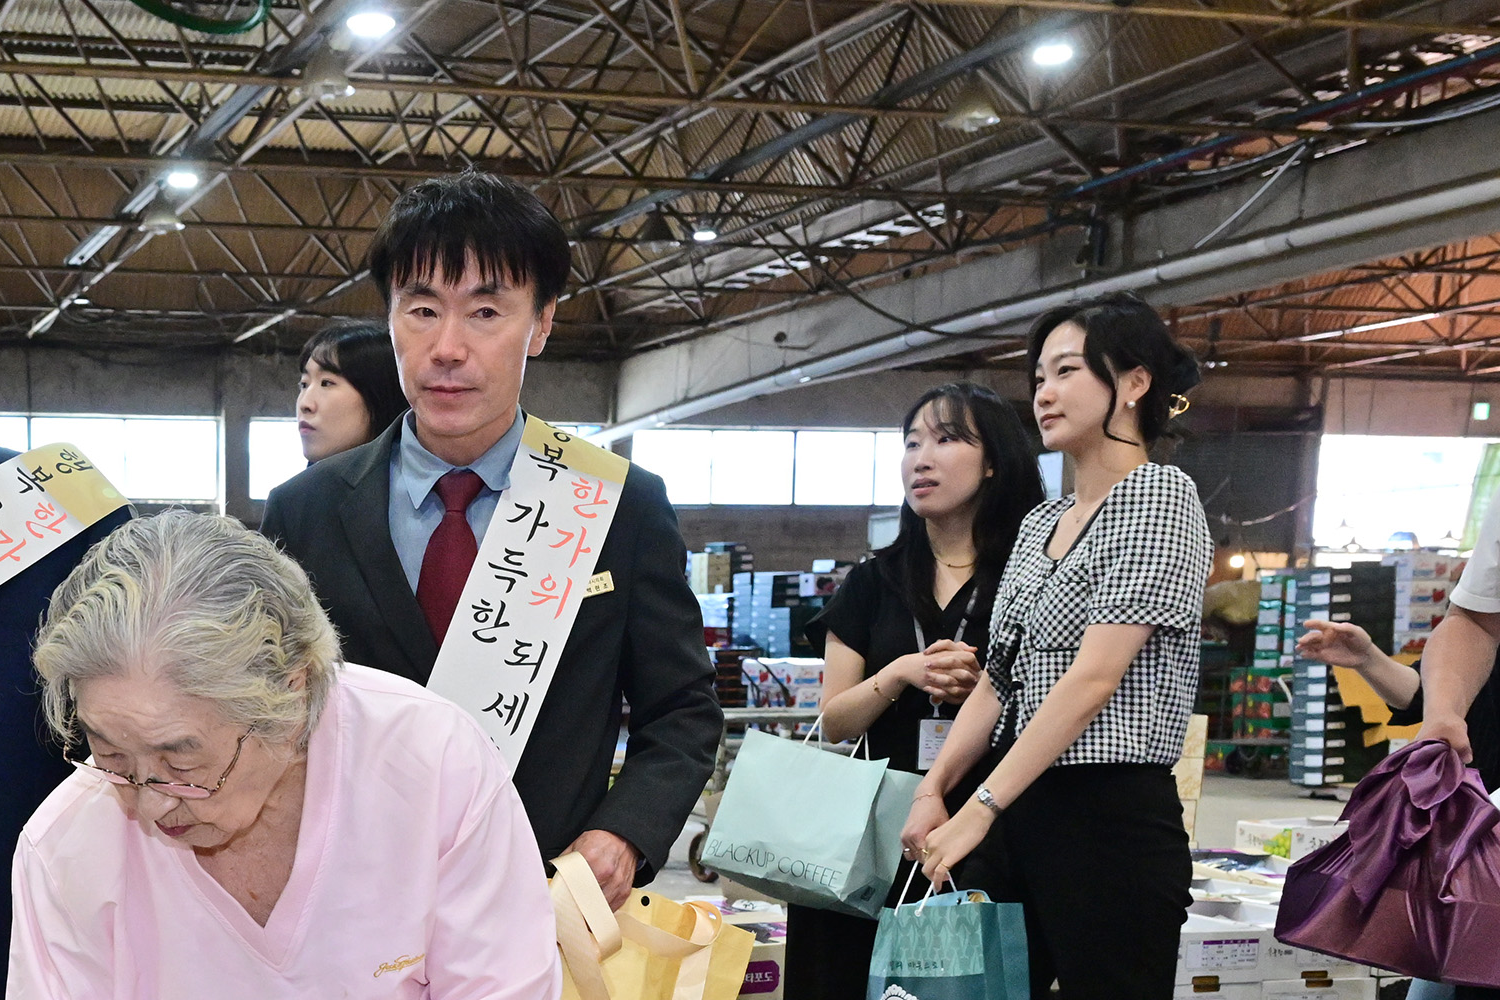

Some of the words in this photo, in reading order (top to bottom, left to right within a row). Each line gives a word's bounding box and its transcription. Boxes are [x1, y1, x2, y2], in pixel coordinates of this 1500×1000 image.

[17, 448, 93, 495] 행복
[471, 499, 550, 643] 가득한
[527, 476, 610, 621] 한가위
[481, 641, 550, 750] 되세
[706, 838, 776, 873] BLACKUP
[777, 857, 844, 888] COFFEE
[744, 967, 774, 985] 타포도
